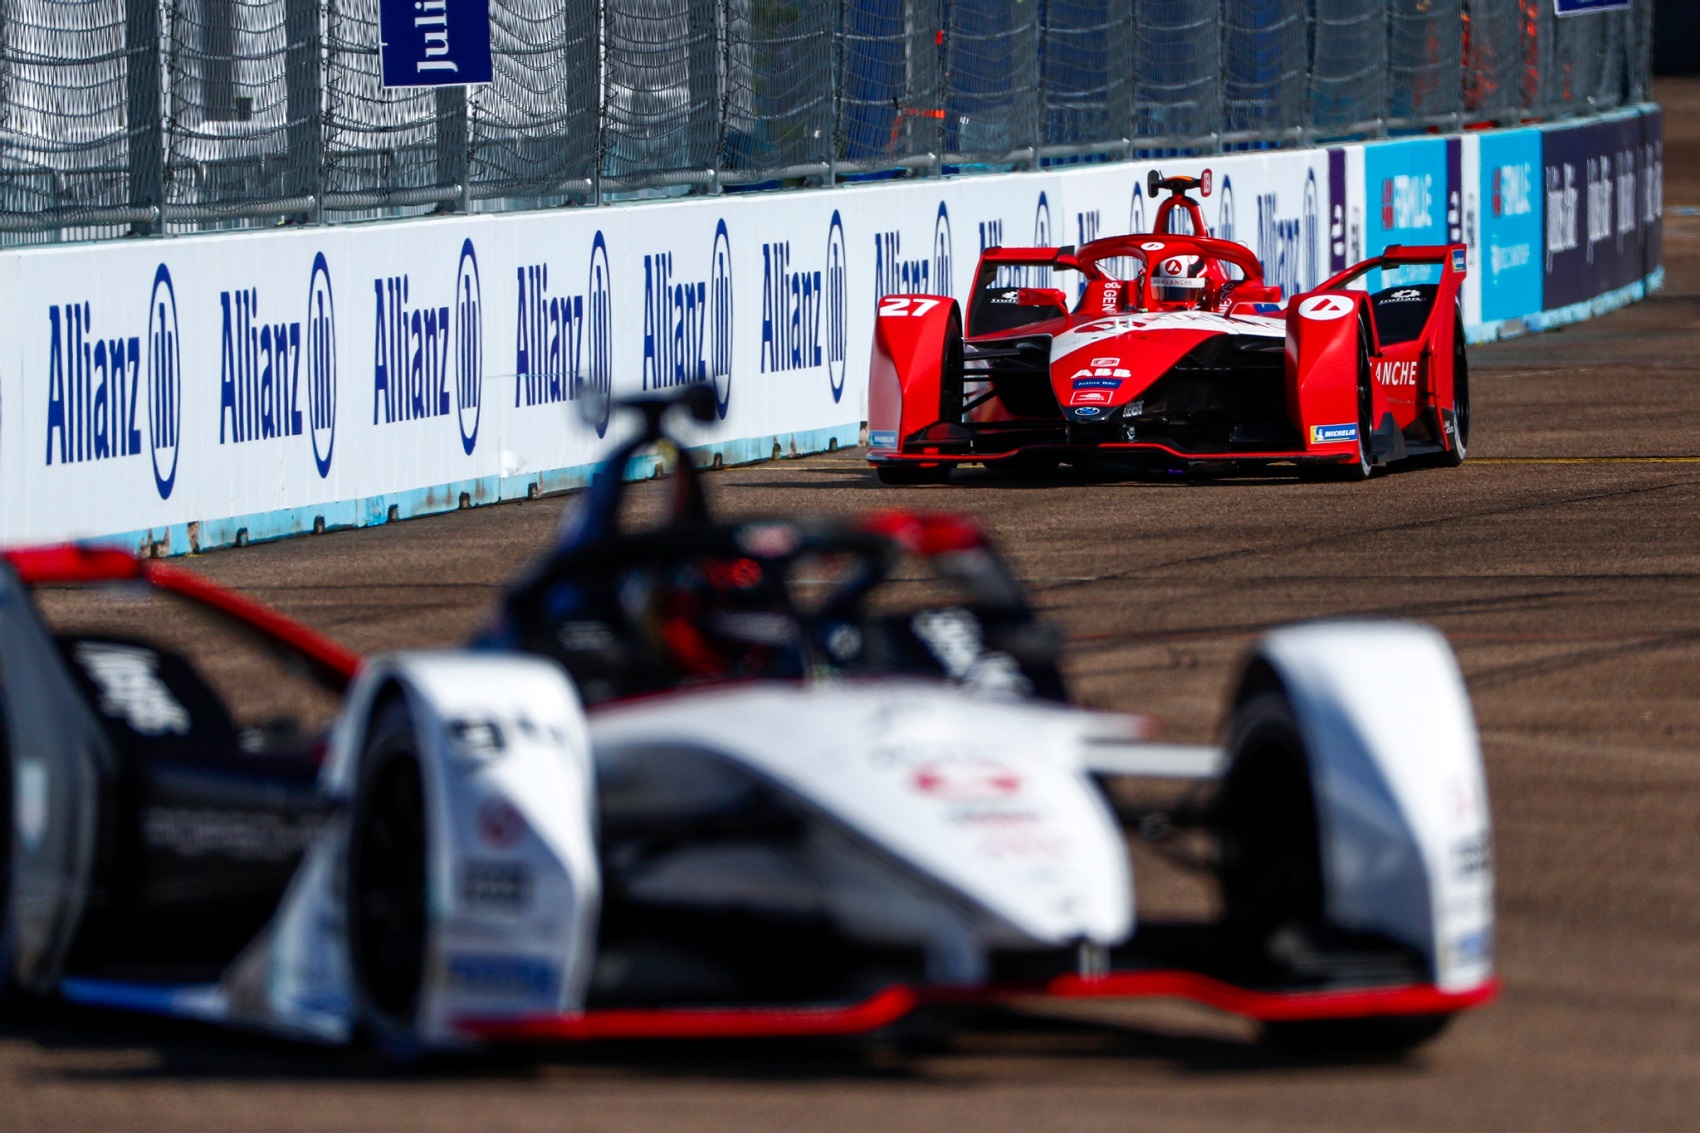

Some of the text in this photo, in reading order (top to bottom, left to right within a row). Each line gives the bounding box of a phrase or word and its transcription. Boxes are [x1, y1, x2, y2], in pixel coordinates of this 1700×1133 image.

[414, 0, 459, 73] Juli
[220, 288, 302, 444] Allianz
[374, 275, 449, 425] Allianz
[515, 262, 583, 408] Allianz
[643, 250, 706, 391] Allianz
[761, 240, 822, 373] Allianz
[879, 298, 940, 317] 27
[46, 300, 141, 466] Allianz
[1070, 368, 1132, 379] ABB
[1324, 429, 1356, 438] MICHELIN
[1370, 361, 1418, 386] ANCHE
